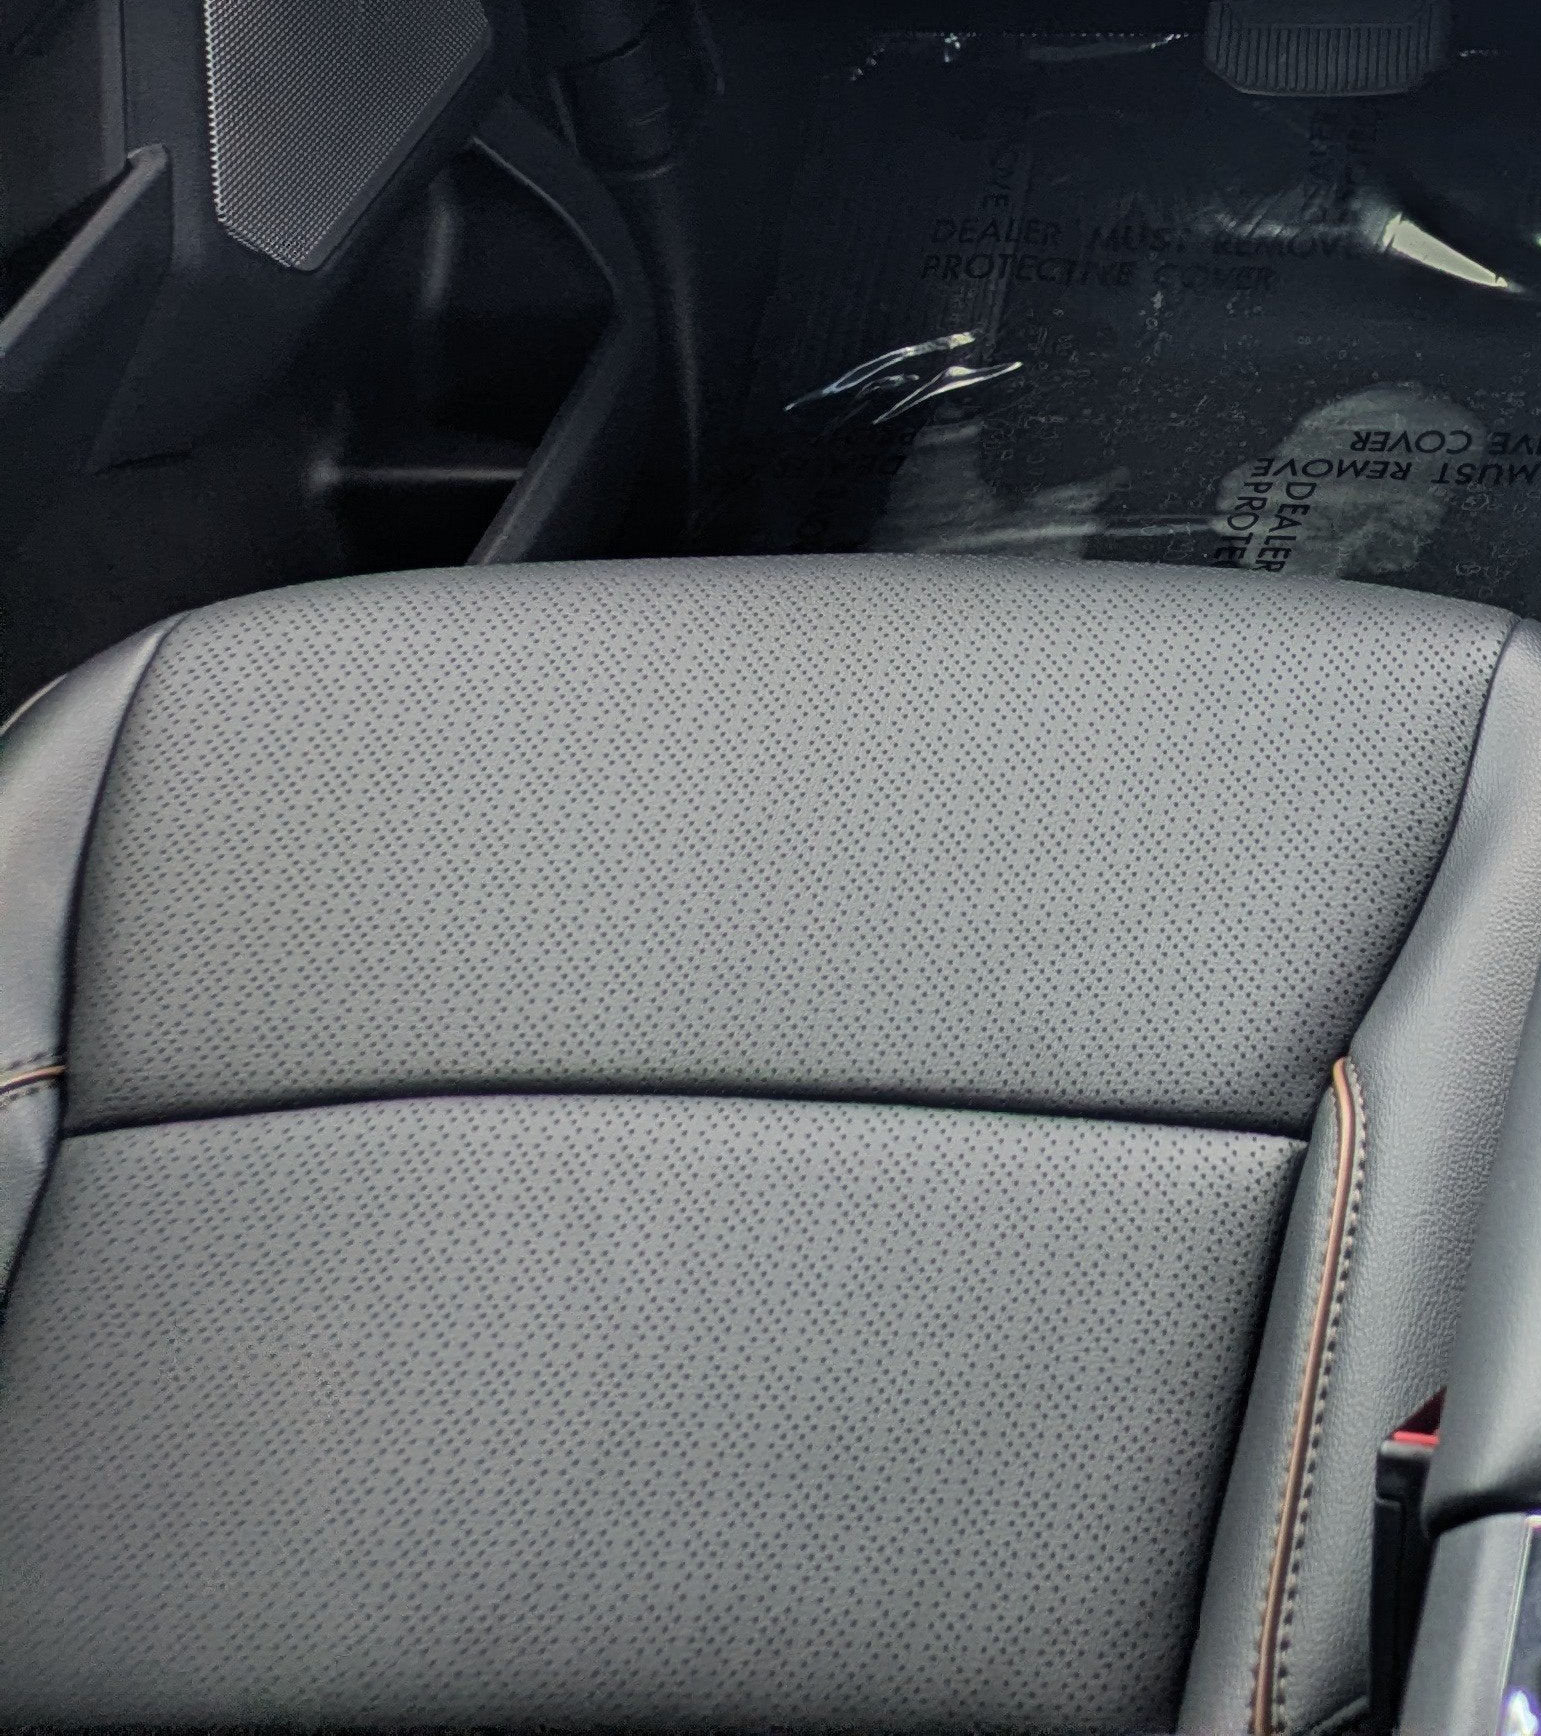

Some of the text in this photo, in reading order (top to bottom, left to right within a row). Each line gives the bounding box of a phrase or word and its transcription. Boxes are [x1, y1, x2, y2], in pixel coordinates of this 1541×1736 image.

[1350, 429, 1474, 454] COVER
[1233, 454, 1413, 483] REMOVE
[1431, 461, 1540, 486] MUST
[1250, 482, 1317, 573] DEALER
